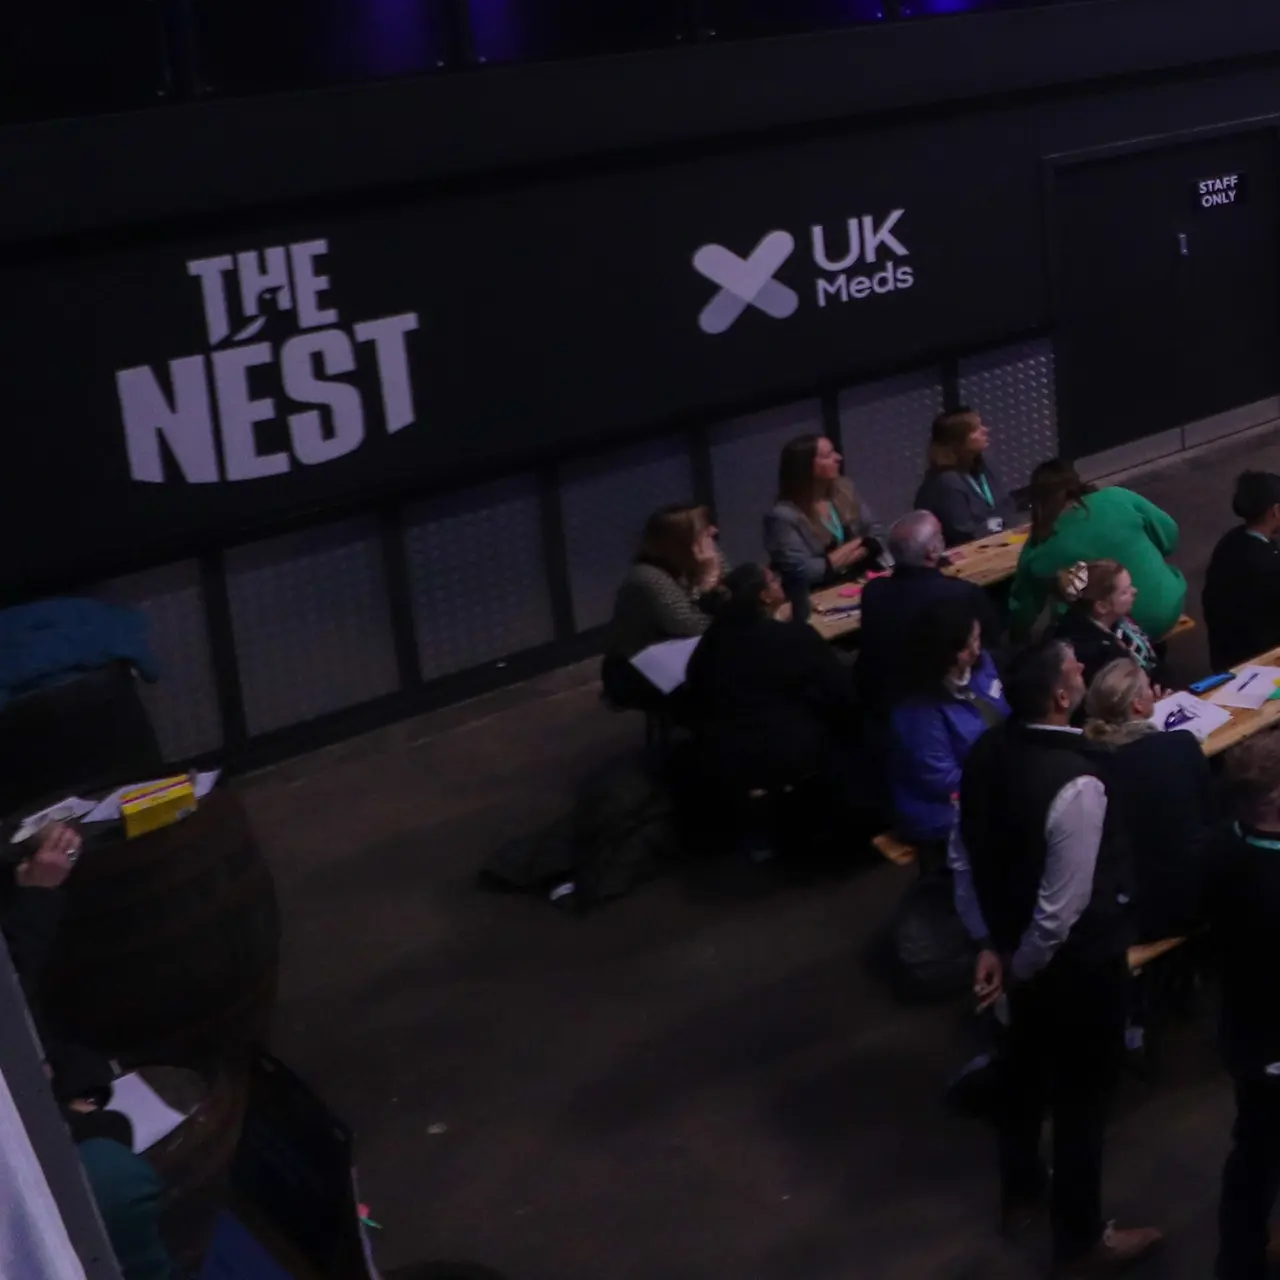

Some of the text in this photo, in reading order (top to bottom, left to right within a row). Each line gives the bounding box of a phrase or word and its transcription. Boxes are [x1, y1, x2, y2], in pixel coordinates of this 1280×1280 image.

[1199, 175, 1239, 194] STAFF
[1201, 189, 1237, 208] ONLY
[810, 207, 911, 273] UK
[186, 237, 340, 348] THE
[815, 264, 915, 310] Meds
[115, 310, 420, 484] NEST
